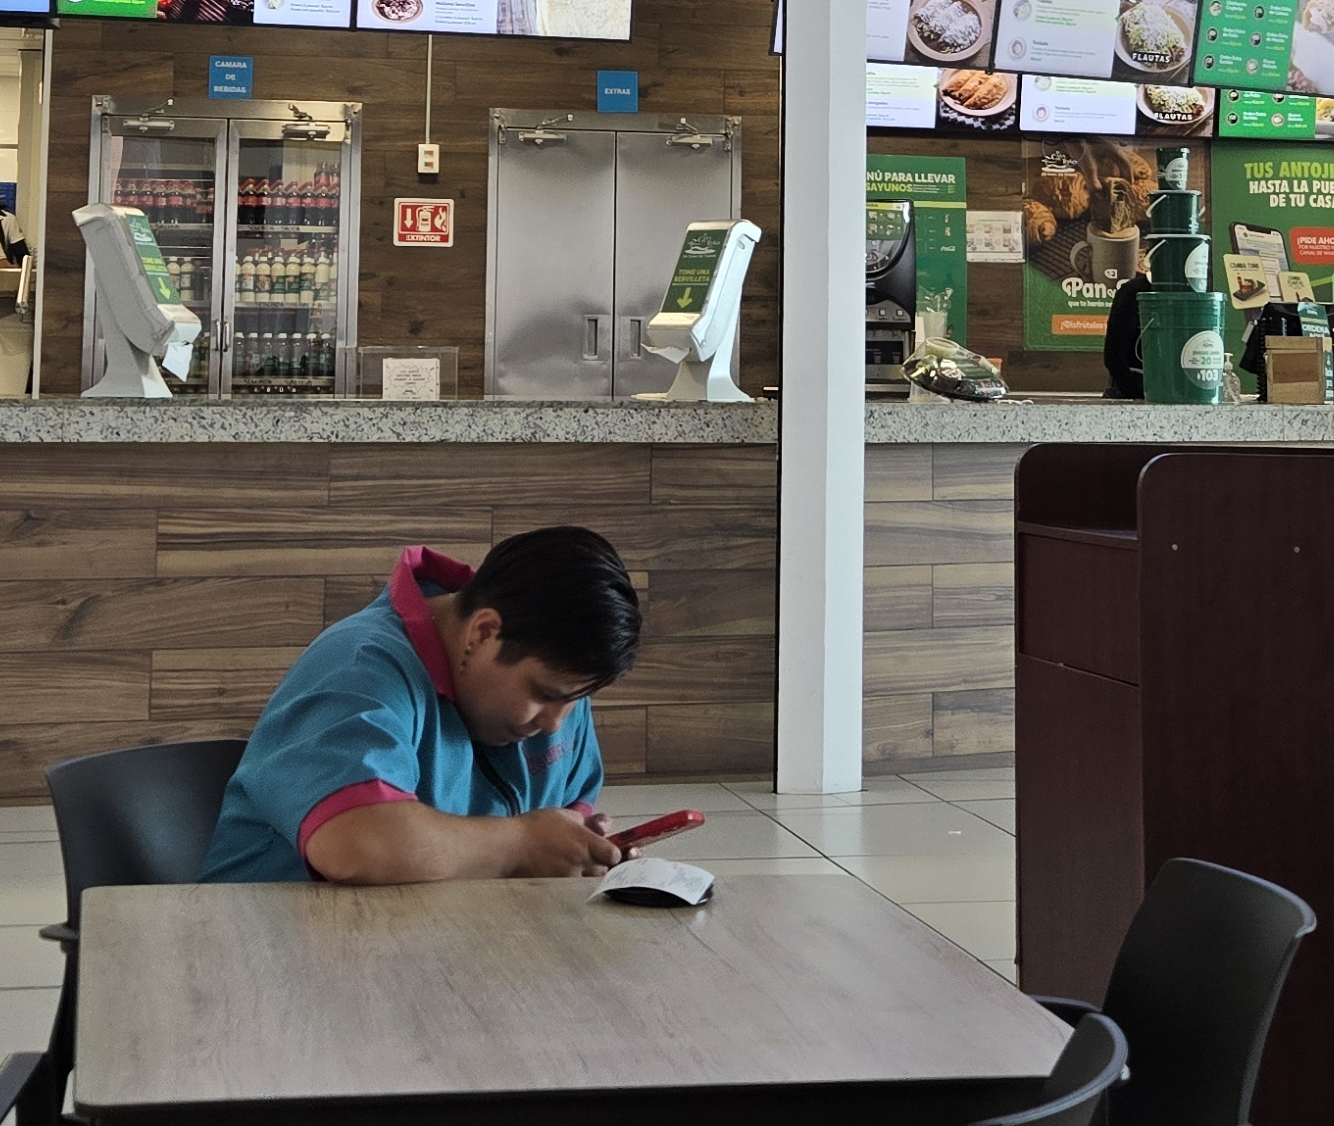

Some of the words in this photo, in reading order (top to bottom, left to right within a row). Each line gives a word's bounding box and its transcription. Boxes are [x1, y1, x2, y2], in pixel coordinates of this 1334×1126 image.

[1132, 52, 1171, 63] FLAUTAS
[214, 60, 247, 68] CAMARA
[213, 85, 246, 93] BEBIDAS
[1244, 162, 1273, 178] TUS
[884, 172, 913, 182] PARA
[914, 173, 956, 184] LLEVAR
[1249, 180, 1290, 194] HASTA
[1293, 180, 1309, 193] LA
[1269, 194, 1286, 207] DE
[1289, 194, 1305, 207] TU
[1062, 277, 1107, 298] Pan
[1201, 356, 1212, 366] 20
